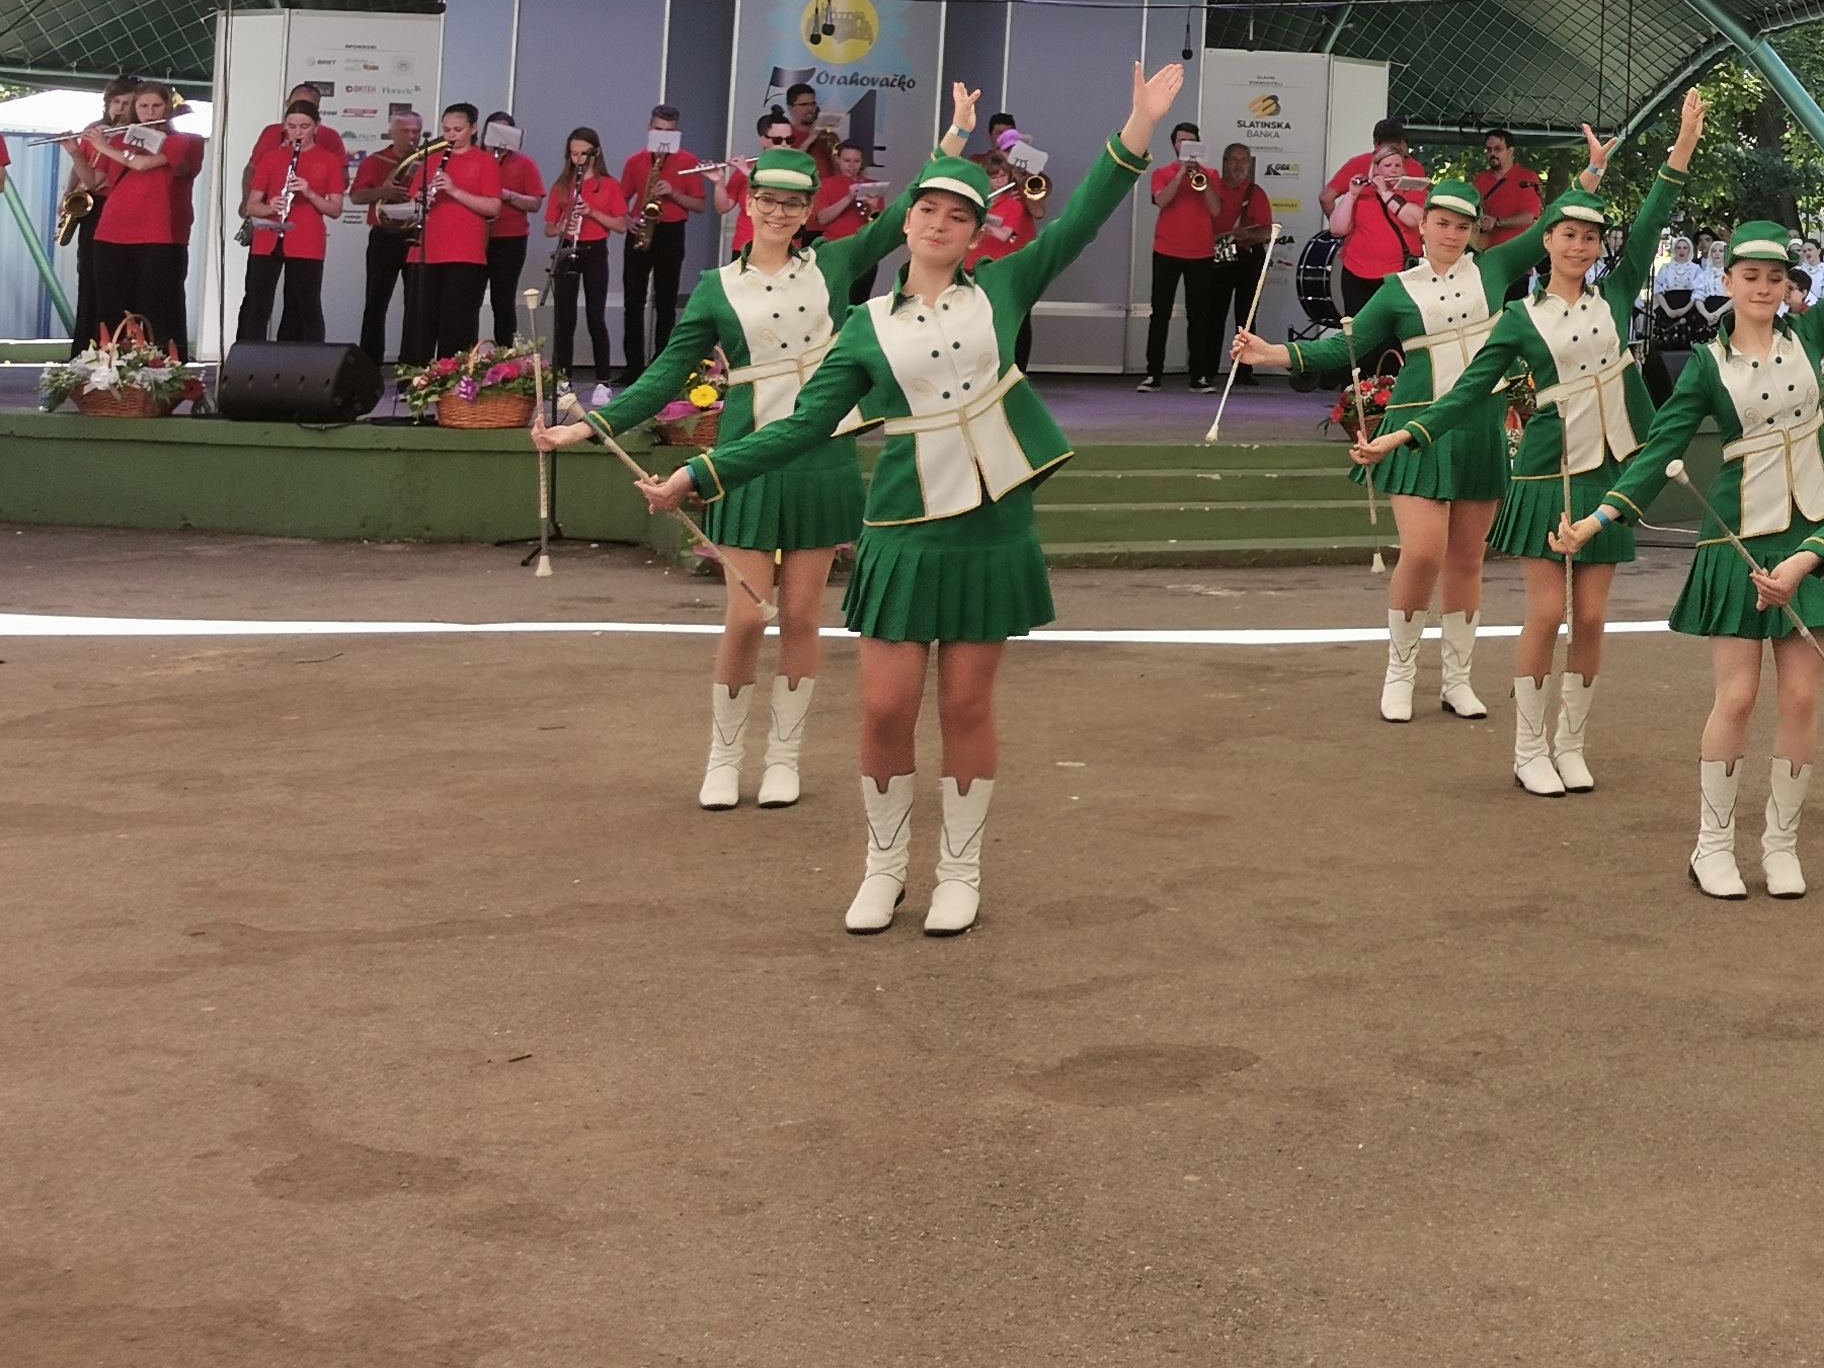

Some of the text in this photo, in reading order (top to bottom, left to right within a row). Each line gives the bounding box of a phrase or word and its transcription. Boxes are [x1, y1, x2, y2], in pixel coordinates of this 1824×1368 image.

[815, 70, 916, 92] Orahovačko
[1236, 119, 1292, 130] SLATINSKA
[1246, 130, 1281, 139] BANKA
